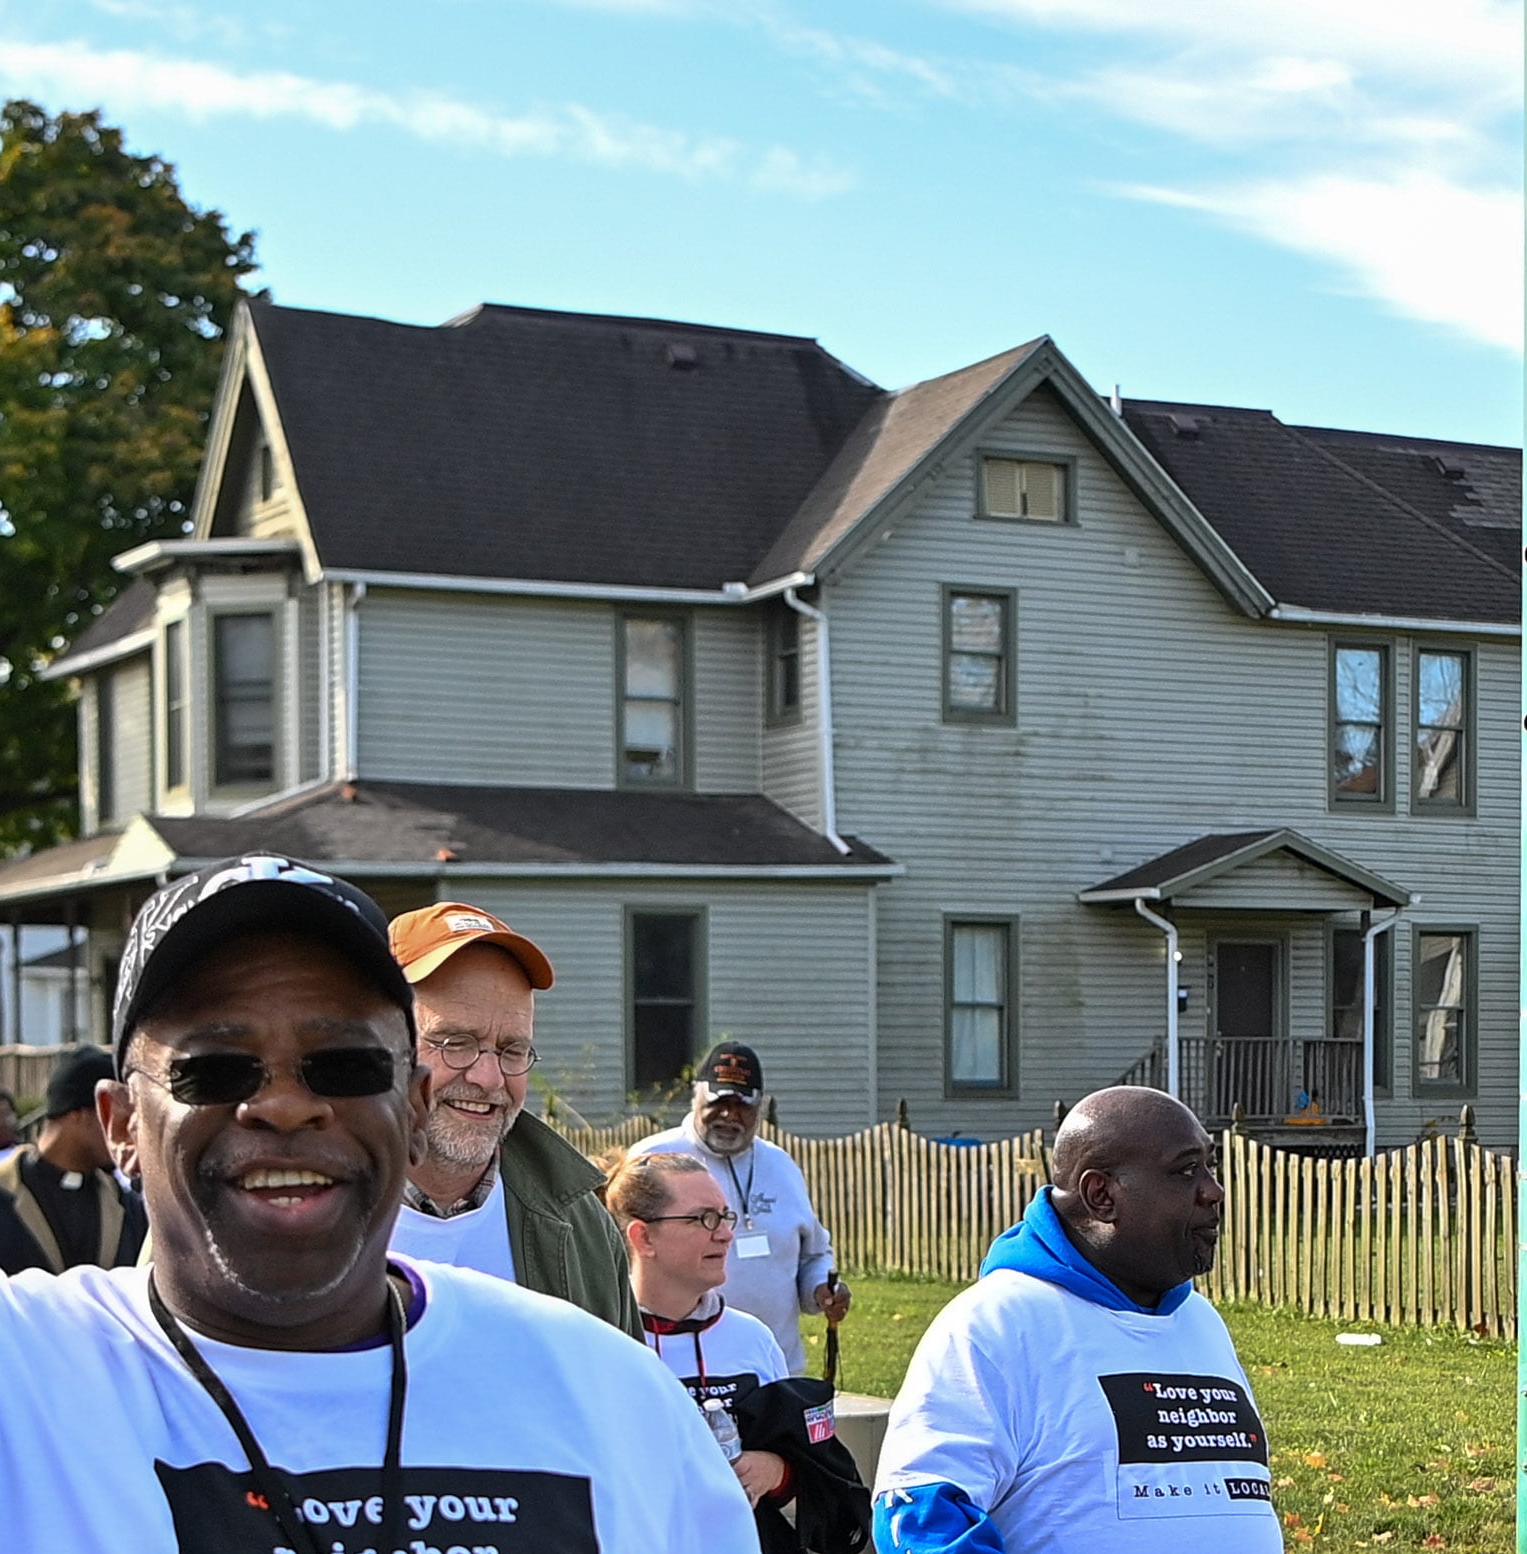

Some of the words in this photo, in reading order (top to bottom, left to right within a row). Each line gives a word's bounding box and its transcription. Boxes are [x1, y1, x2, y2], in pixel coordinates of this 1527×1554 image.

[1142, 1382, 1198, 1401] “Love
[1199, 1388, 1238, 1404] your
[1157, 1407, 1237, 1428] neighbor
[1146, 1434, 1168, 1449] as
[1133, 1484, 1193, 1498] Make
[1204, 1483, 1222, 1496] it
[245, 1490, 384, 1528] “ove
[403, 1494, 519, 1531] your
